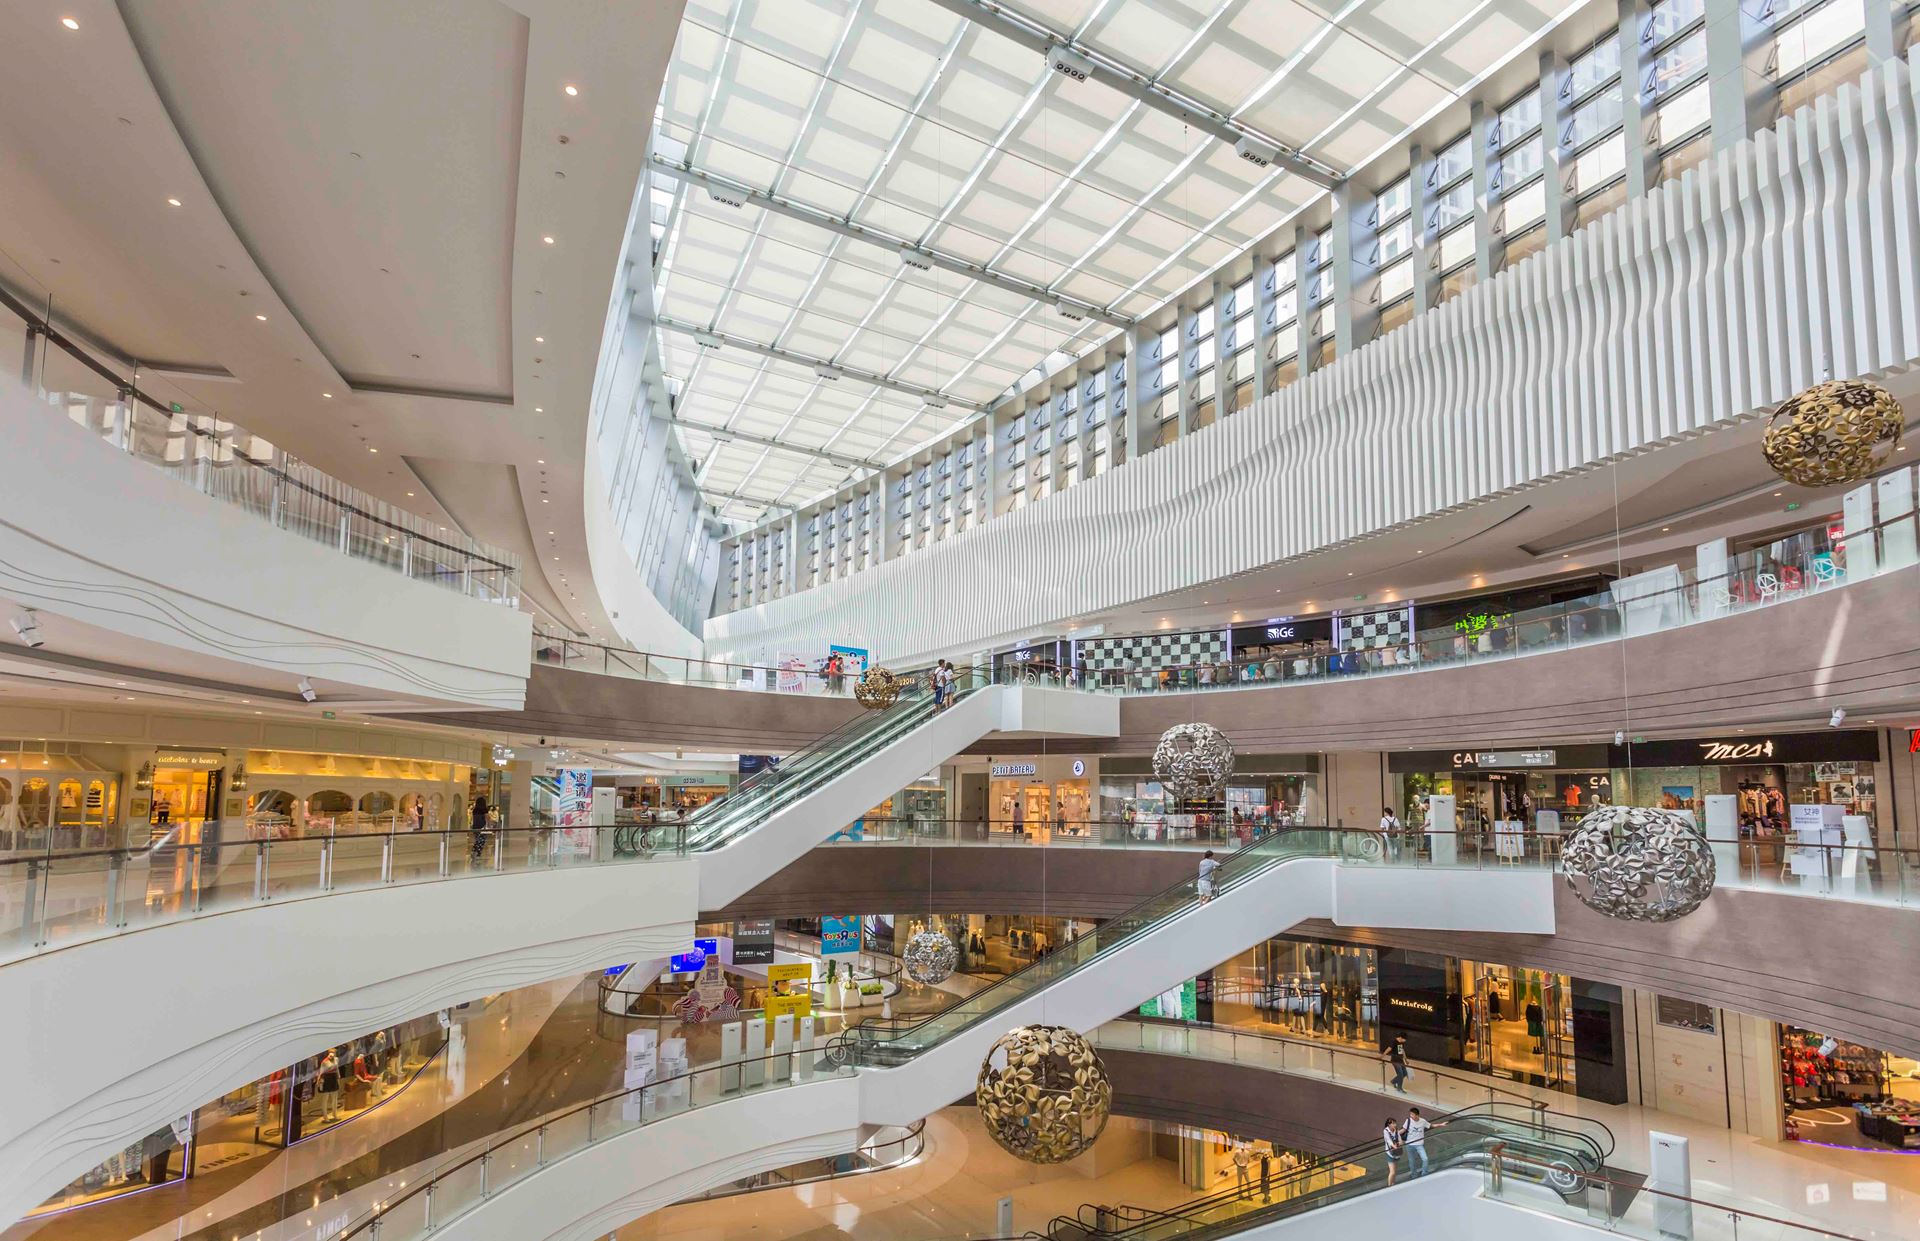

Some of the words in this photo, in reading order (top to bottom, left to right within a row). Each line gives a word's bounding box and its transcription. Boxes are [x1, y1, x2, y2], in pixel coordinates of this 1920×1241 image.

[992, 765, 1009, 775] PETIT
[1010, 764, 1036, 775] BATEAU
[1390, 998, 1433, 1012] Marisfrolg
